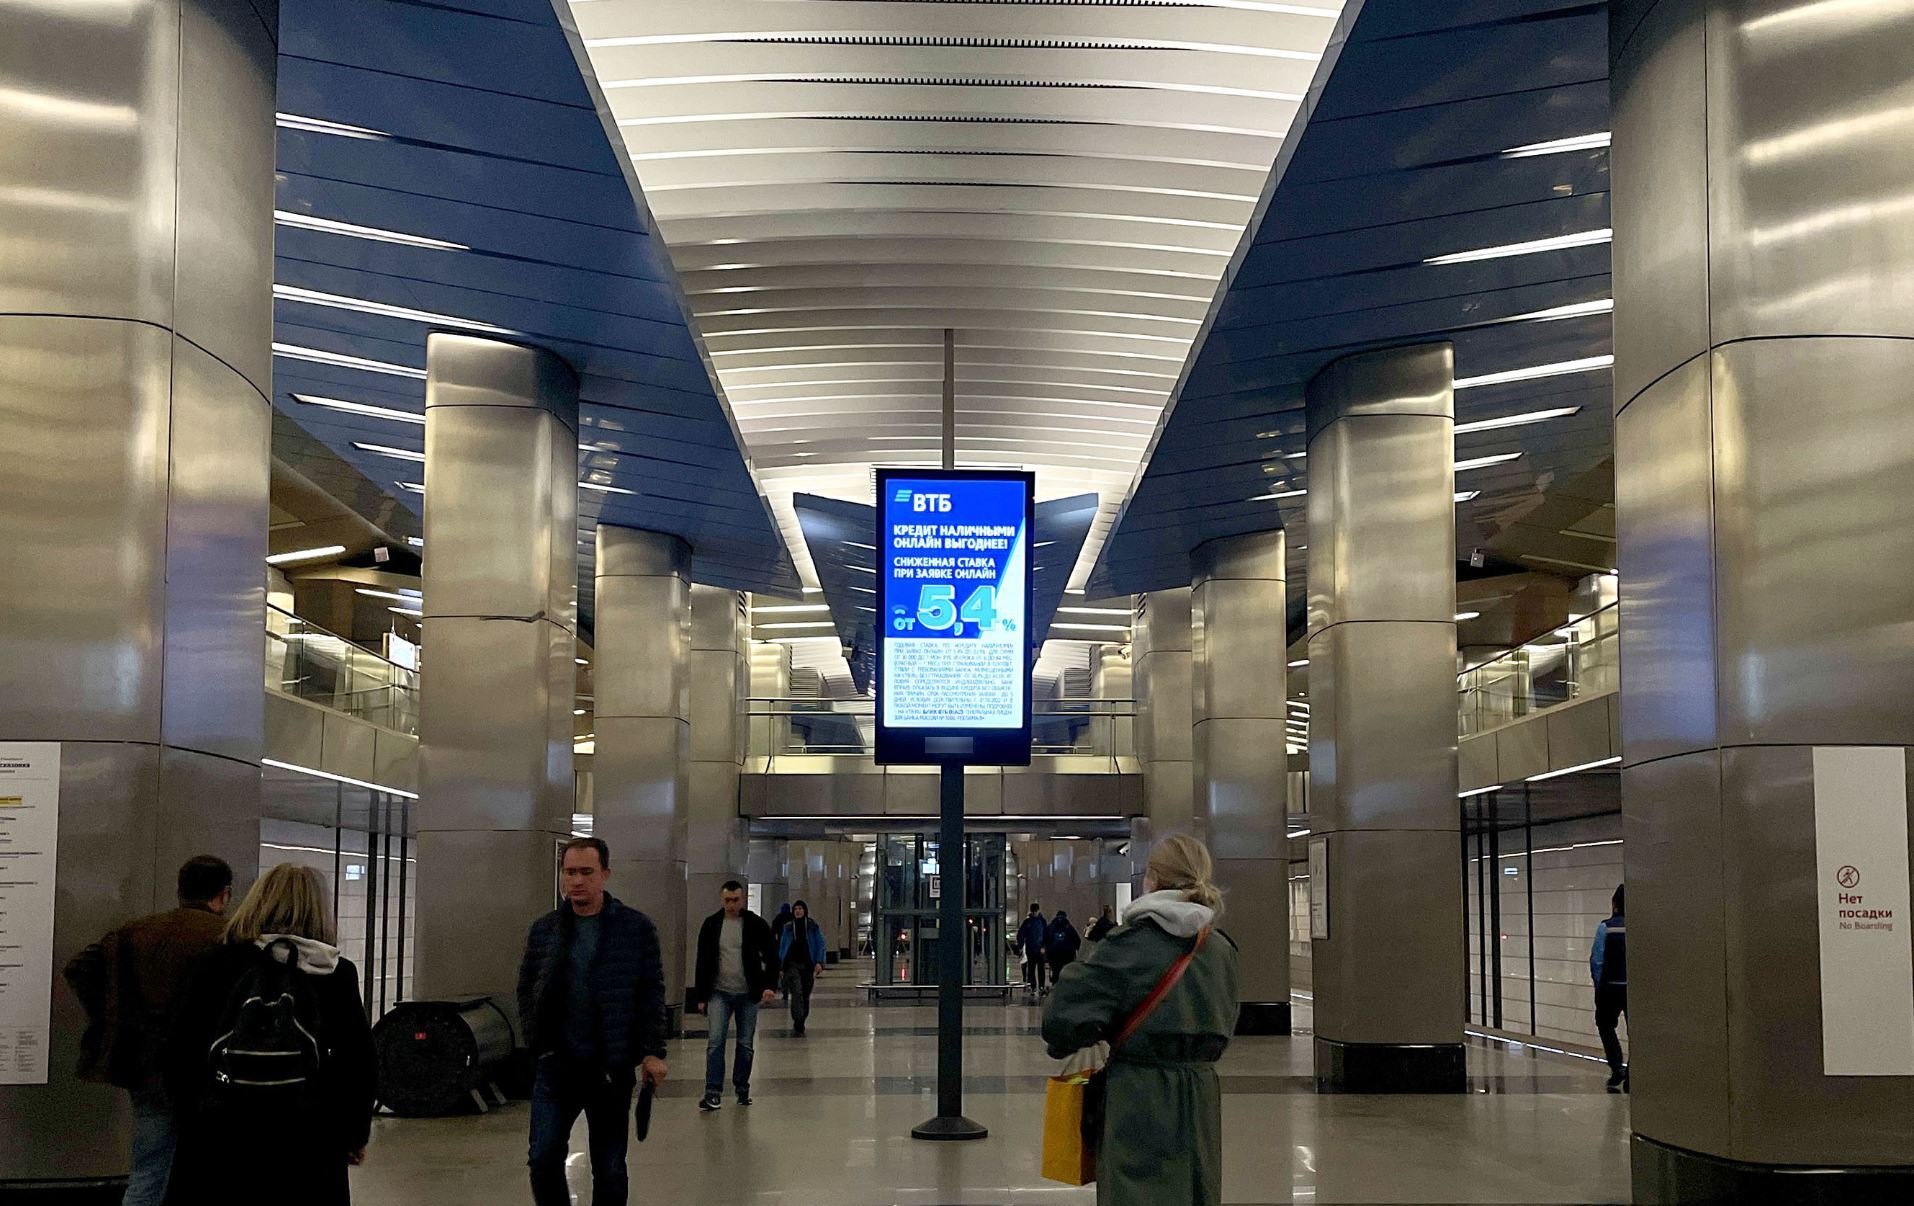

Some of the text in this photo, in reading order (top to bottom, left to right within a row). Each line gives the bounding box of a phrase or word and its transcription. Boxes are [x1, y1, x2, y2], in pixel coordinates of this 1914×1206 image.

[913, 493, 952, 512] ВТБ
[893, 525, 1015, 538] КРЕДИТ НАЛИЧНЫМИ
[893, 537, 1008, 551] ОНЛАЙН ВЫГОДНЕЕ!
[893, 557, 995, 568] СНИЖЕННАЯ СТАВКА
[894, 567, 996, 579] ПРИ ЗАЯВКЕ ОНЛАЙН
[917, 584, 997, 636] 5,4
[1002, 618, 1016, 632] %
[1838, 893, 1863, 904] Нет
[1838, 910, 1893, 920] посадки
[1839, 922, 1893, 931] No Boarding
